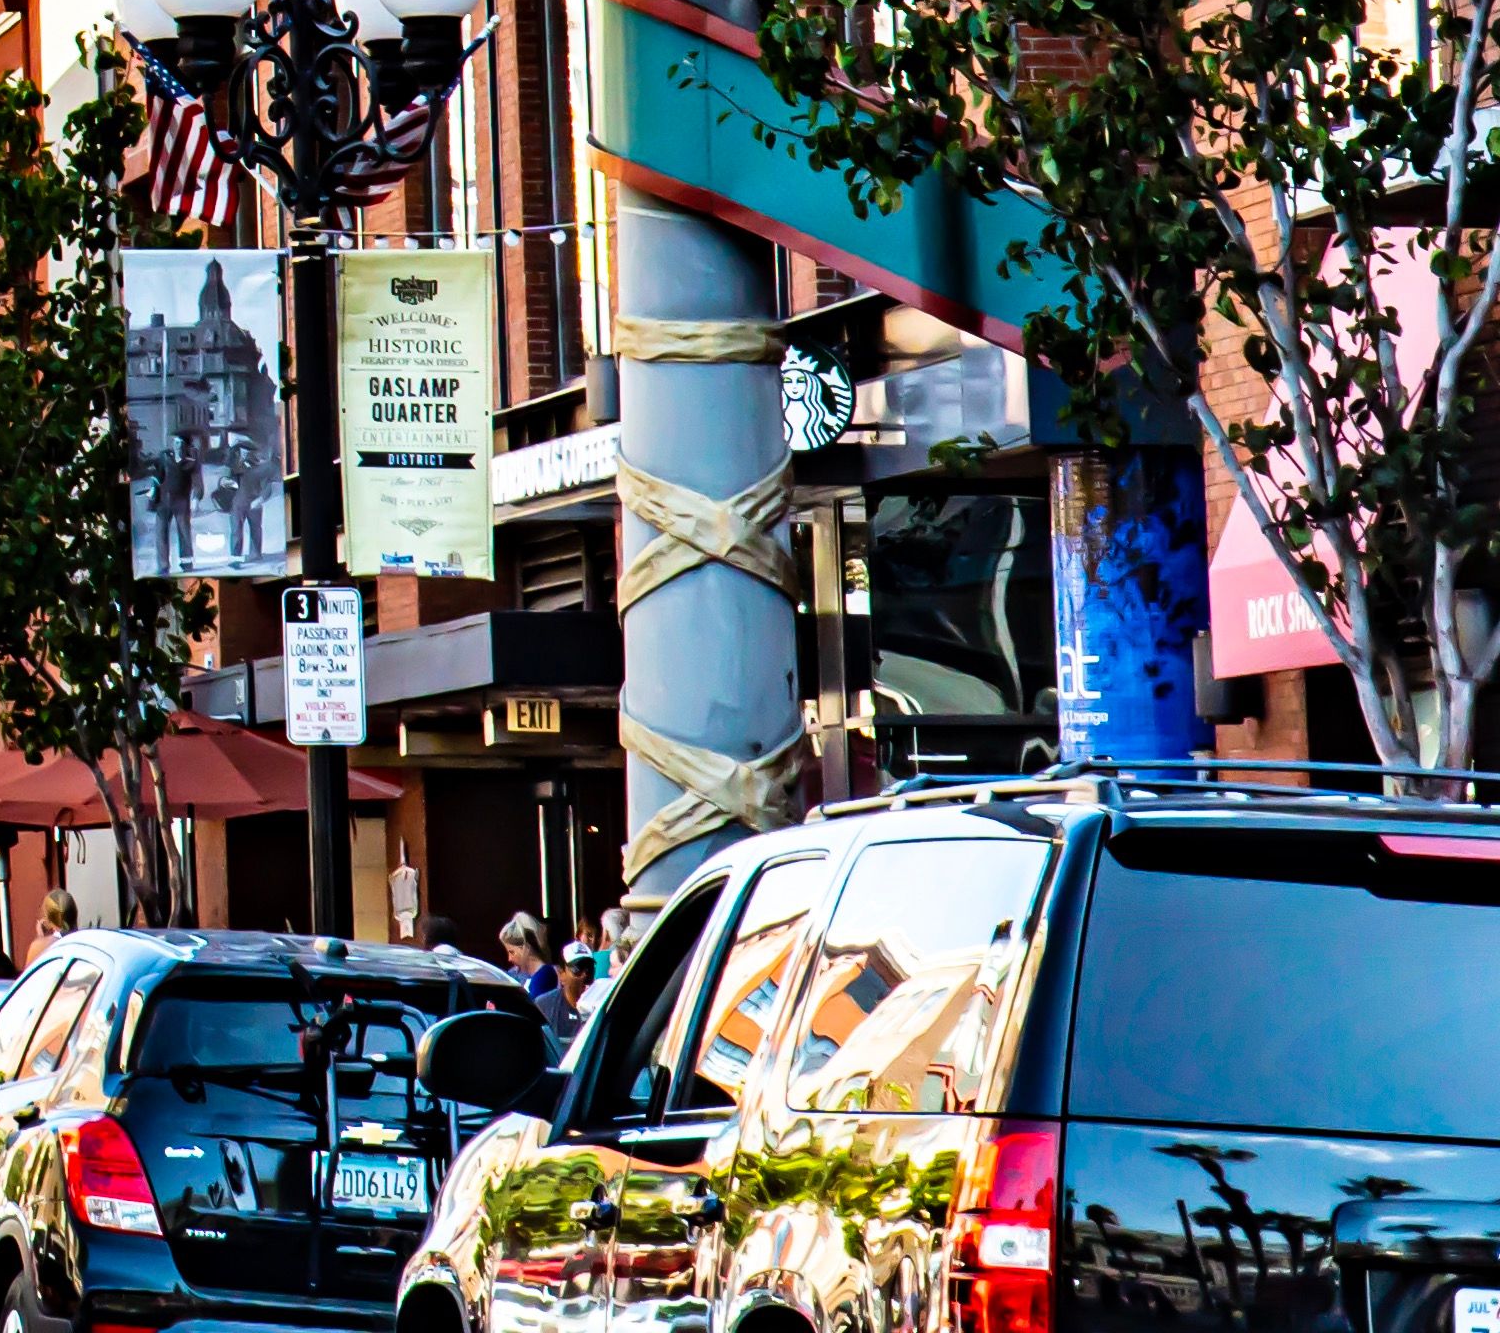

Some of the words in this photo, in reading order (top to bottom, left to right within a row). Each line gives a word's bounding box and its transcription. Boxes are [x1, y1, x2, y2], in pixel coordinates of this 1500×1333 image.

[376, 312, 453, 329] WELCOME
[368, 338, 462, 354] HISTORIC
[360, 357, 395, 366] HEART
[397, 358, 410, 366] OF
[414, 358, 433, 366] SAN
[368, 377, 460, 398] GASLAMP
[372, 402, 458, 424] QUARTER
[362, 431, 469, 444] ENTERTAINMENT
[388, 453, 445, 466] DISTRICT
[297, 593, 309, 620] 3
[1247, 594, 1285, 640] ROCK
[1287, 590, 1326, 633] SHO
[297, 627, 348, 641] PASSENGER
[290, 644, 328, 657] LOADING
[332, 644, 357, 657] ONLY
[517, 700, 553, 730] EXIT
